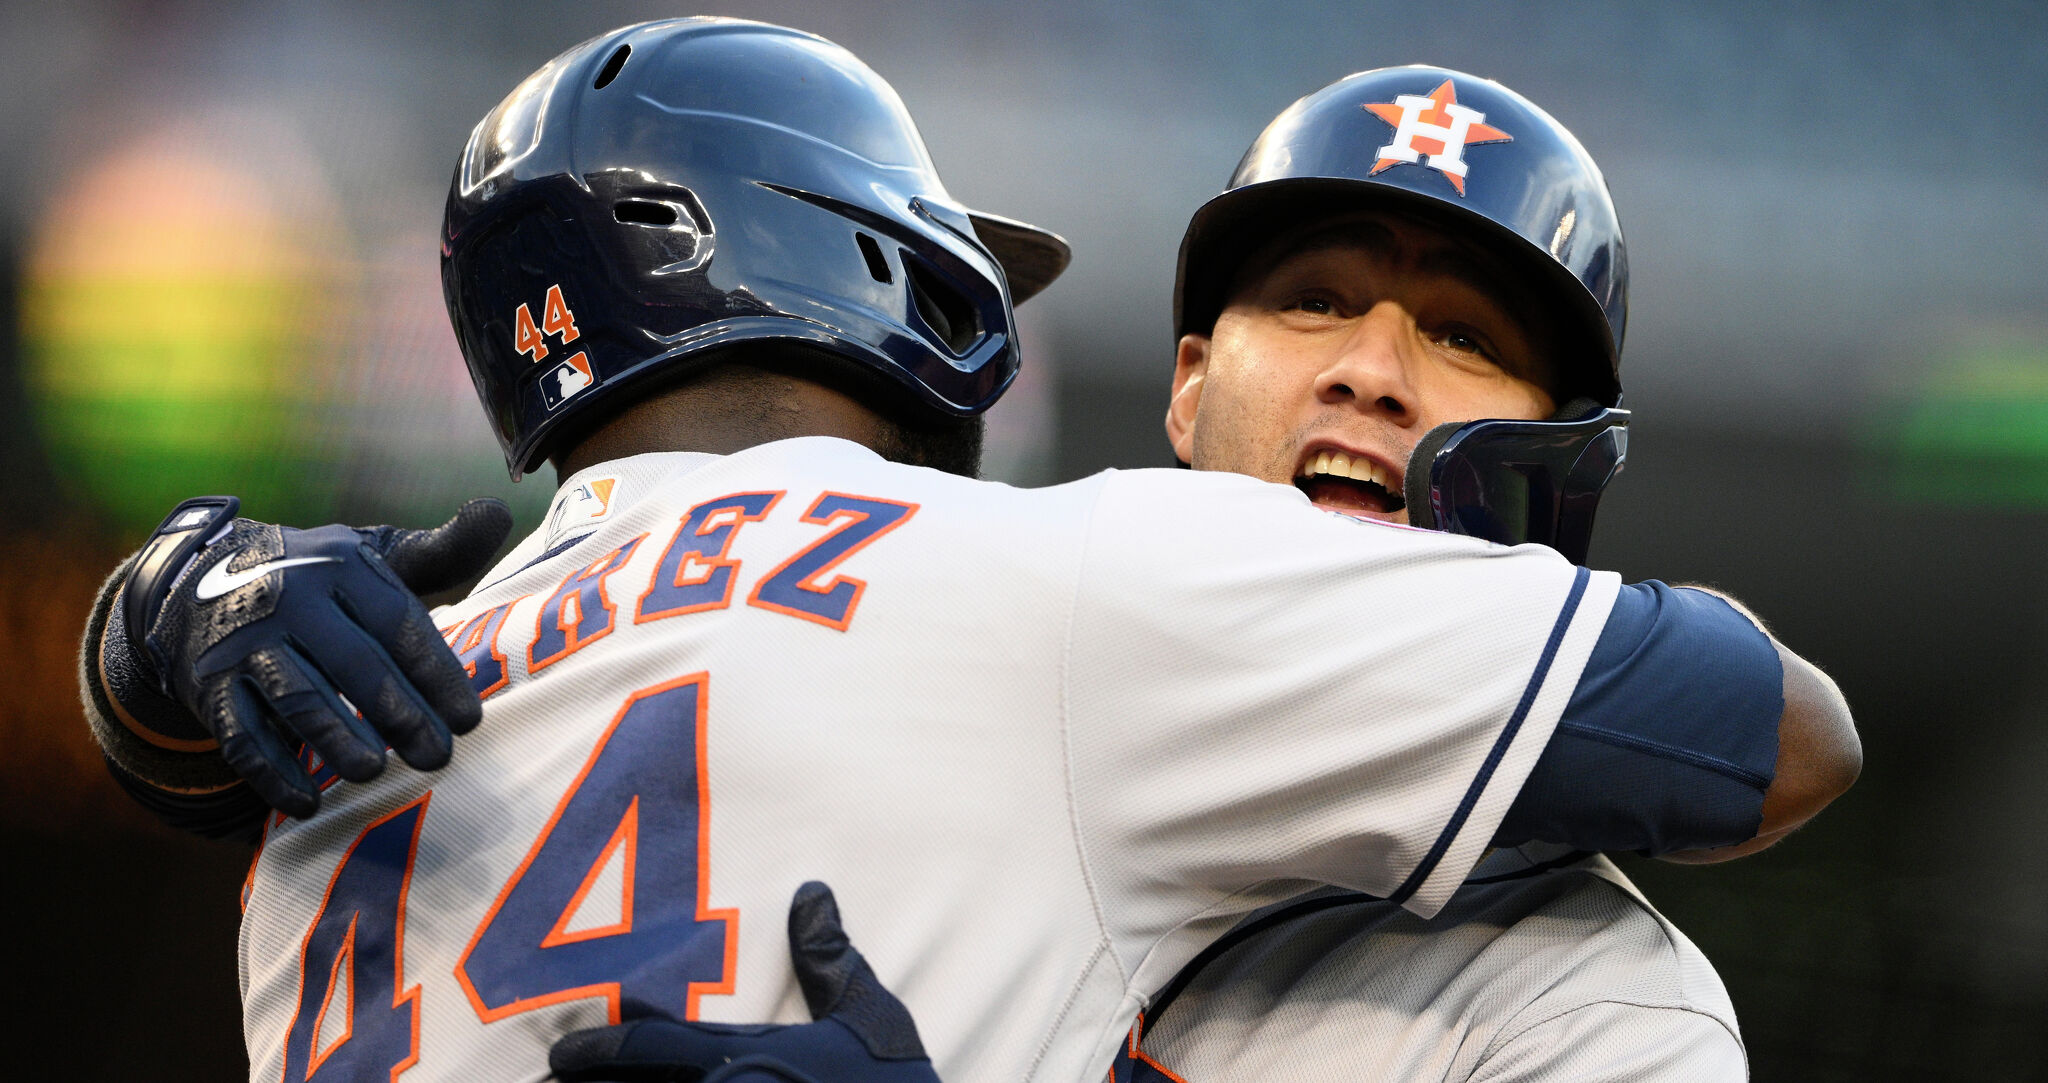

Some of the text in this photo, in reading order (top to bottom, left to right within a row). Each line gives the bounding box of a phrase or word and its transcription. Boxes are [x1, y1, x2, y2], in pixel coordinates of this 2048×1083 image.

[1378, 95, 1486, 178] H
[515, 284, 581, 363] 44
[282, 671, 739, 1083] 44
